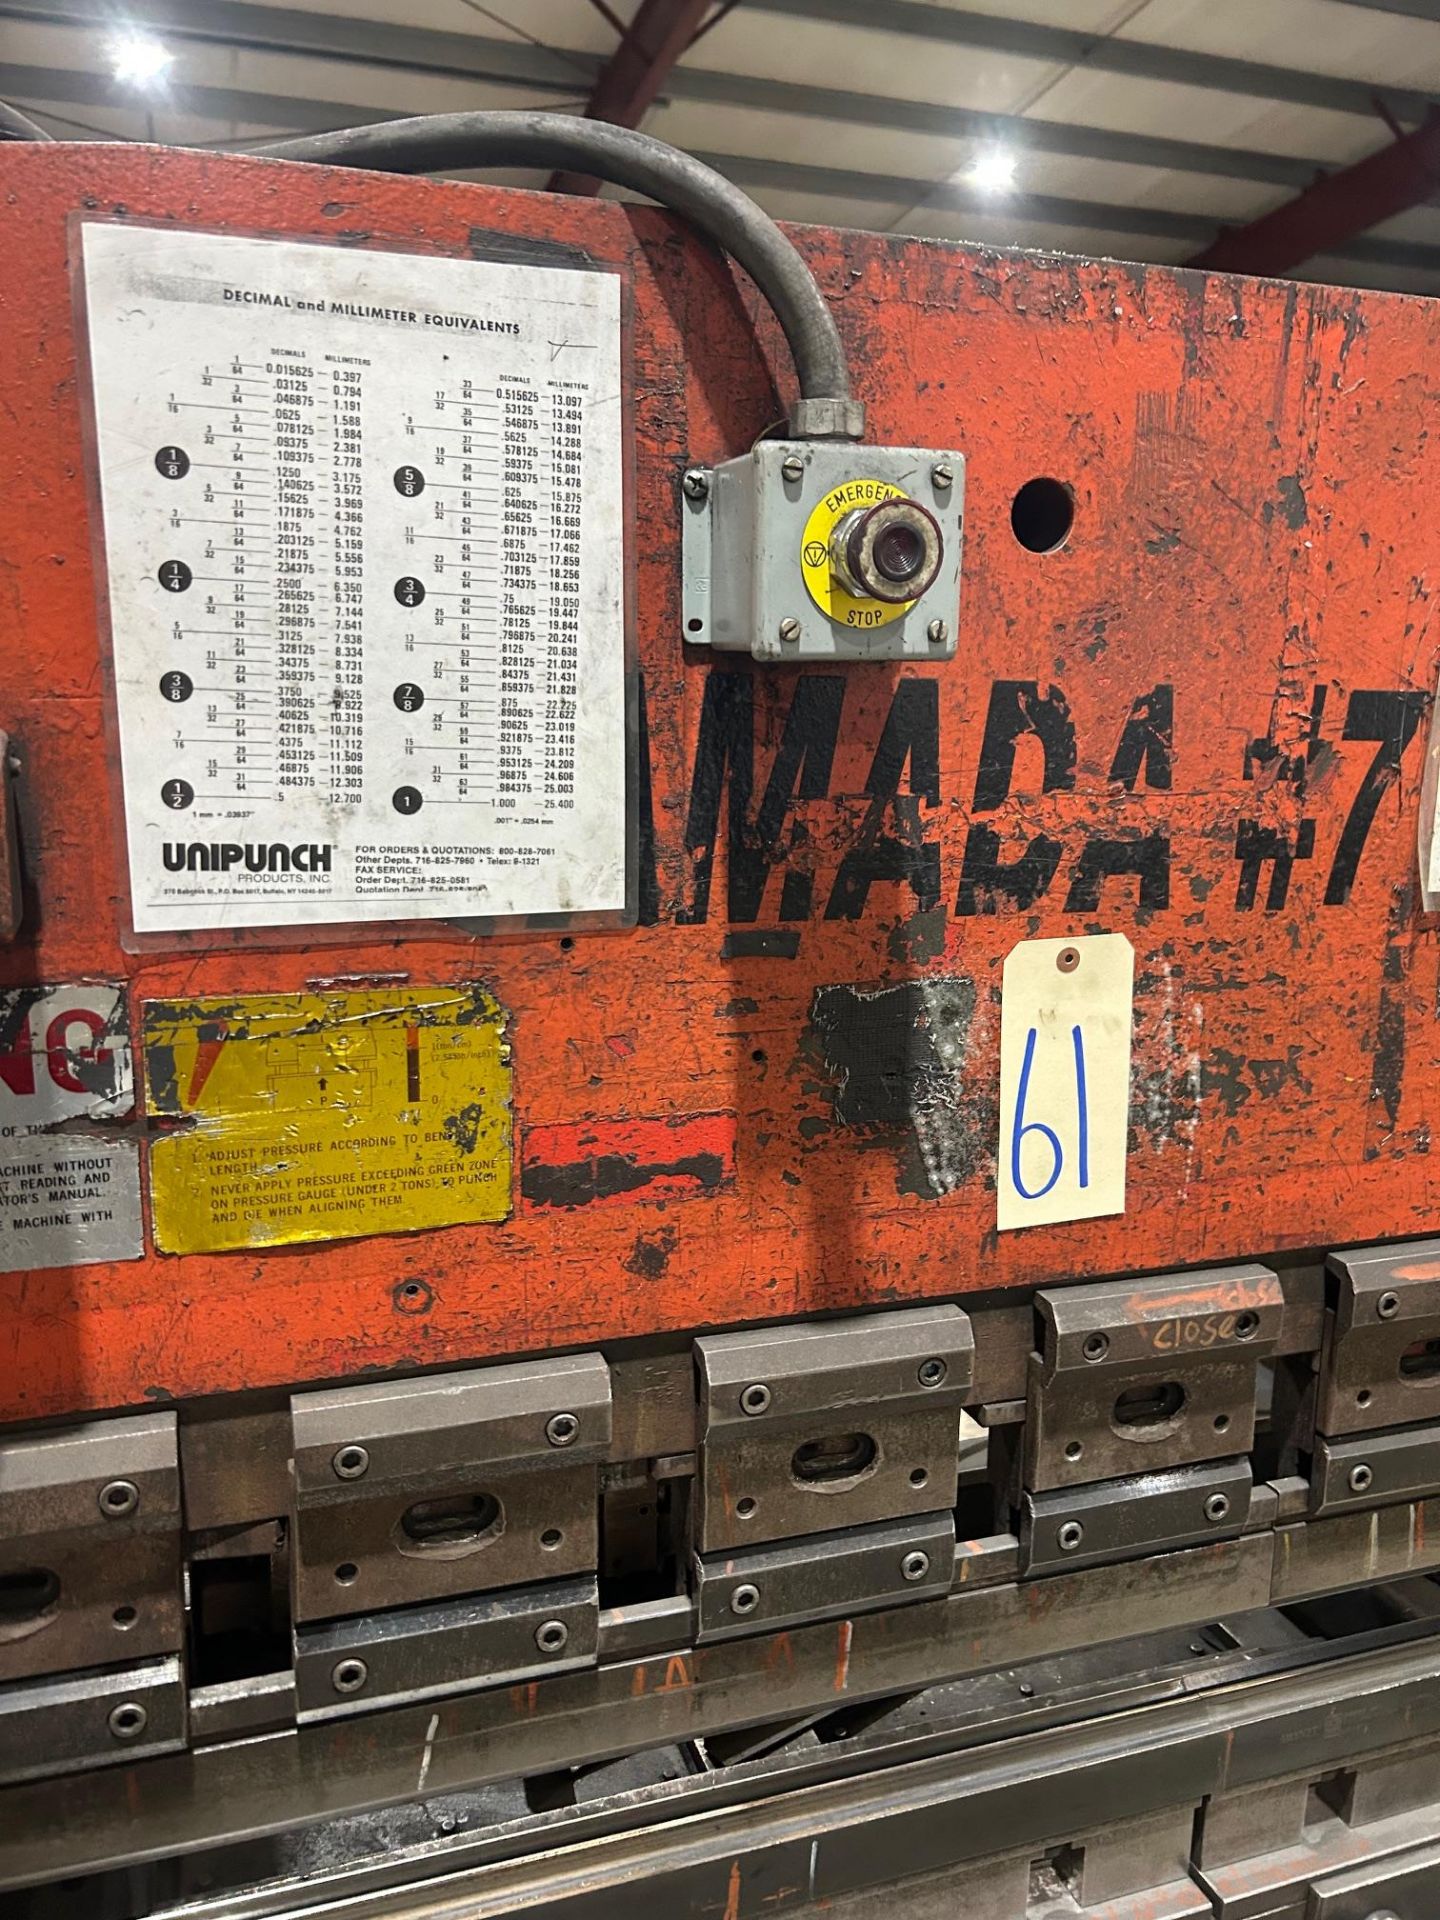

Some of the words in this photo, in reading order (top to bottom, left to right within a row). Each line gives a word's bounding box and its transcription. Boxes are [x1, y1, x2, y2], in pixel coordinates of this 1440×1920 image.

[223, 288, 292, 308] DECIMAL
[297, 299, 325, 312] and
[330, 302, 417, 323] MILLIMETER
[424, 313, 521, 335] EQUIVALENTS
[270, 347, 306, 358] DECIMALS
[324, 354, 371, 366] MILLIMETERS
[266, 363, 314, 378] 0.015625
[333, 371, 362, 384] 0.397
[273, 379, 307, 392] .03125
[334, 386, 362, 398] 0.794
[499, 374, 531, 385] DECIMALS
[547, 381, 589, 391] MILLIMETERS
[497, 389, 539, 402] 0.515625
[552, 395, 582, 407] 13.097
[273, 409, 300, 420] .0625
[334, 414, 361, 426] 1.588
[502, 405, 534, 416] .53125
[552, 409, 582, 421] 13.494
[502, 432, 527, 443] .5625
[552, 436, 581, 448] 14.288
[273, 467, 300, 478] .1250
[333, 472, 361, 483] 3.175
[502, 487, 521, 497] .625
[552, 491, 582, 502] 15.875
[826, 484, 900, 514] EMERGEN
[335, 497, 362, 509] 3.969
[273, 521, 302, 532] .1875
[335, 525, 362, 537] 4.762
[501, 539, 525, 549] .6875
[550, 543, 580, 554] 17.462
[275, 549, 309, 560] .21875
[335, 552, 362, 563] 5.556
[501, 566, 531, 575] .71875
[550, 568, 580, 579] 18.256
[274, 579, 301, 589] .2500
[334, 582, 362, 593] 6.350
[500, 594, 514, 603] .75
[550, 597, 579, 608] 19.050
[276, 603, 309, 613] .28125
[336, 607, 362, 617] 7.144
[847, 610, 883, 627] STOP
[275, 631, 302, 641] .3125
[335, 634, 362, 644] 7.938
[499, 644, 524, 653] .8125
[548, 647, 577, 657] 20.638
[276, 658, 309, 668] .34375
[336, 660, 362, 671] 8.731
[499, 670, 529, 680] .84375
[547, 672, 576, 682] 21.431
[275, 687, 302, 696] .3750
[499, 699, 518, 708] .875
[277, 738, 303, 747] .4375
[330, 739, 362, 749] 11.112
[497, 746, 522, 755] .9375
[545, 747, 574, 757] 23.812
[277, 764, 309, 773] .46875
[330, 765, 362, 775] 11.906
[275, 793, 284, 802] .5
[329, 793, 362, 803] 12.700
[491, 799, 515, 808] 1.000
[545, 799, 574, 809] 25.400
[638, 672, 1173, 926] MADA
[1234, 684, 1430, 913] #7
[162, 843, 332, 872] UNIPUNCH
[355, 846, 376, 854] FOR
[379, 846, 420, 855] ORDERS
[422, 846, 429, 855] &
[432, 846, 495, 856] QUOTATIONS:
[355, 856, 381, 864] Other
[384, 856, 413, 866] Depts.
[487, 857, 512, 865] Telex:
[355, 866, 374, 874] FAX
[376, 866, 422, 874] SERVICE:
[355, 876, 381, 884] Order
[384, 876, 407, 885] Dept.
[355, 885, 400, 894] Quotation
[1011, 1025, 1089, 1199] 61
[2, 1127, 17, 1137] OF
[210, 1148, 256, 1162] ADJUST
[262, 1142, 324, 1157] PRESSURE
[330, 1136, 396, 1150] ACCORDING
[403, 1133, 418, 1144] TO
[54, 1158, 112, 1172] WITHOUT
[209, 1162, 257, 1176] LENGTH
[21, 1175, 81, 1190] READING
[84, 1172, 110, 1184] AND
[210, 1182, 251, 1197] NEVER
[255, 1179, 292, 1192] APPLY
[297, 1172, 356, 1188] PRESSURE
[361, 1166, 425, 1181] EXCEEDING
[428, 1162, 465, 1175] GREEN
[468, 1159, 498, 1171] ZONE
[210, 1199, 228, 1210] ON
[233, 1193, 294, 1208] PRESSURE
[297, 1187, 337, 1201] GAUGE
[342, 1183, 386, 1197] (UNDER
[390, 1182, 397, 1192] 2
[458, 1172, 497, 1185] PUNCH
[212, 1211, 238, 1224] AND
[243, 1209, 263, 1221] DIE
[268, 1204, 303, 1218] WHEN
[309, 1199, 366, 1214] ALIGNING
[371, 1194, 403, 1207] THEM
[13, 1214, 72, 1231] MACHINE
[81, 1210, 113, 1222] WITH
